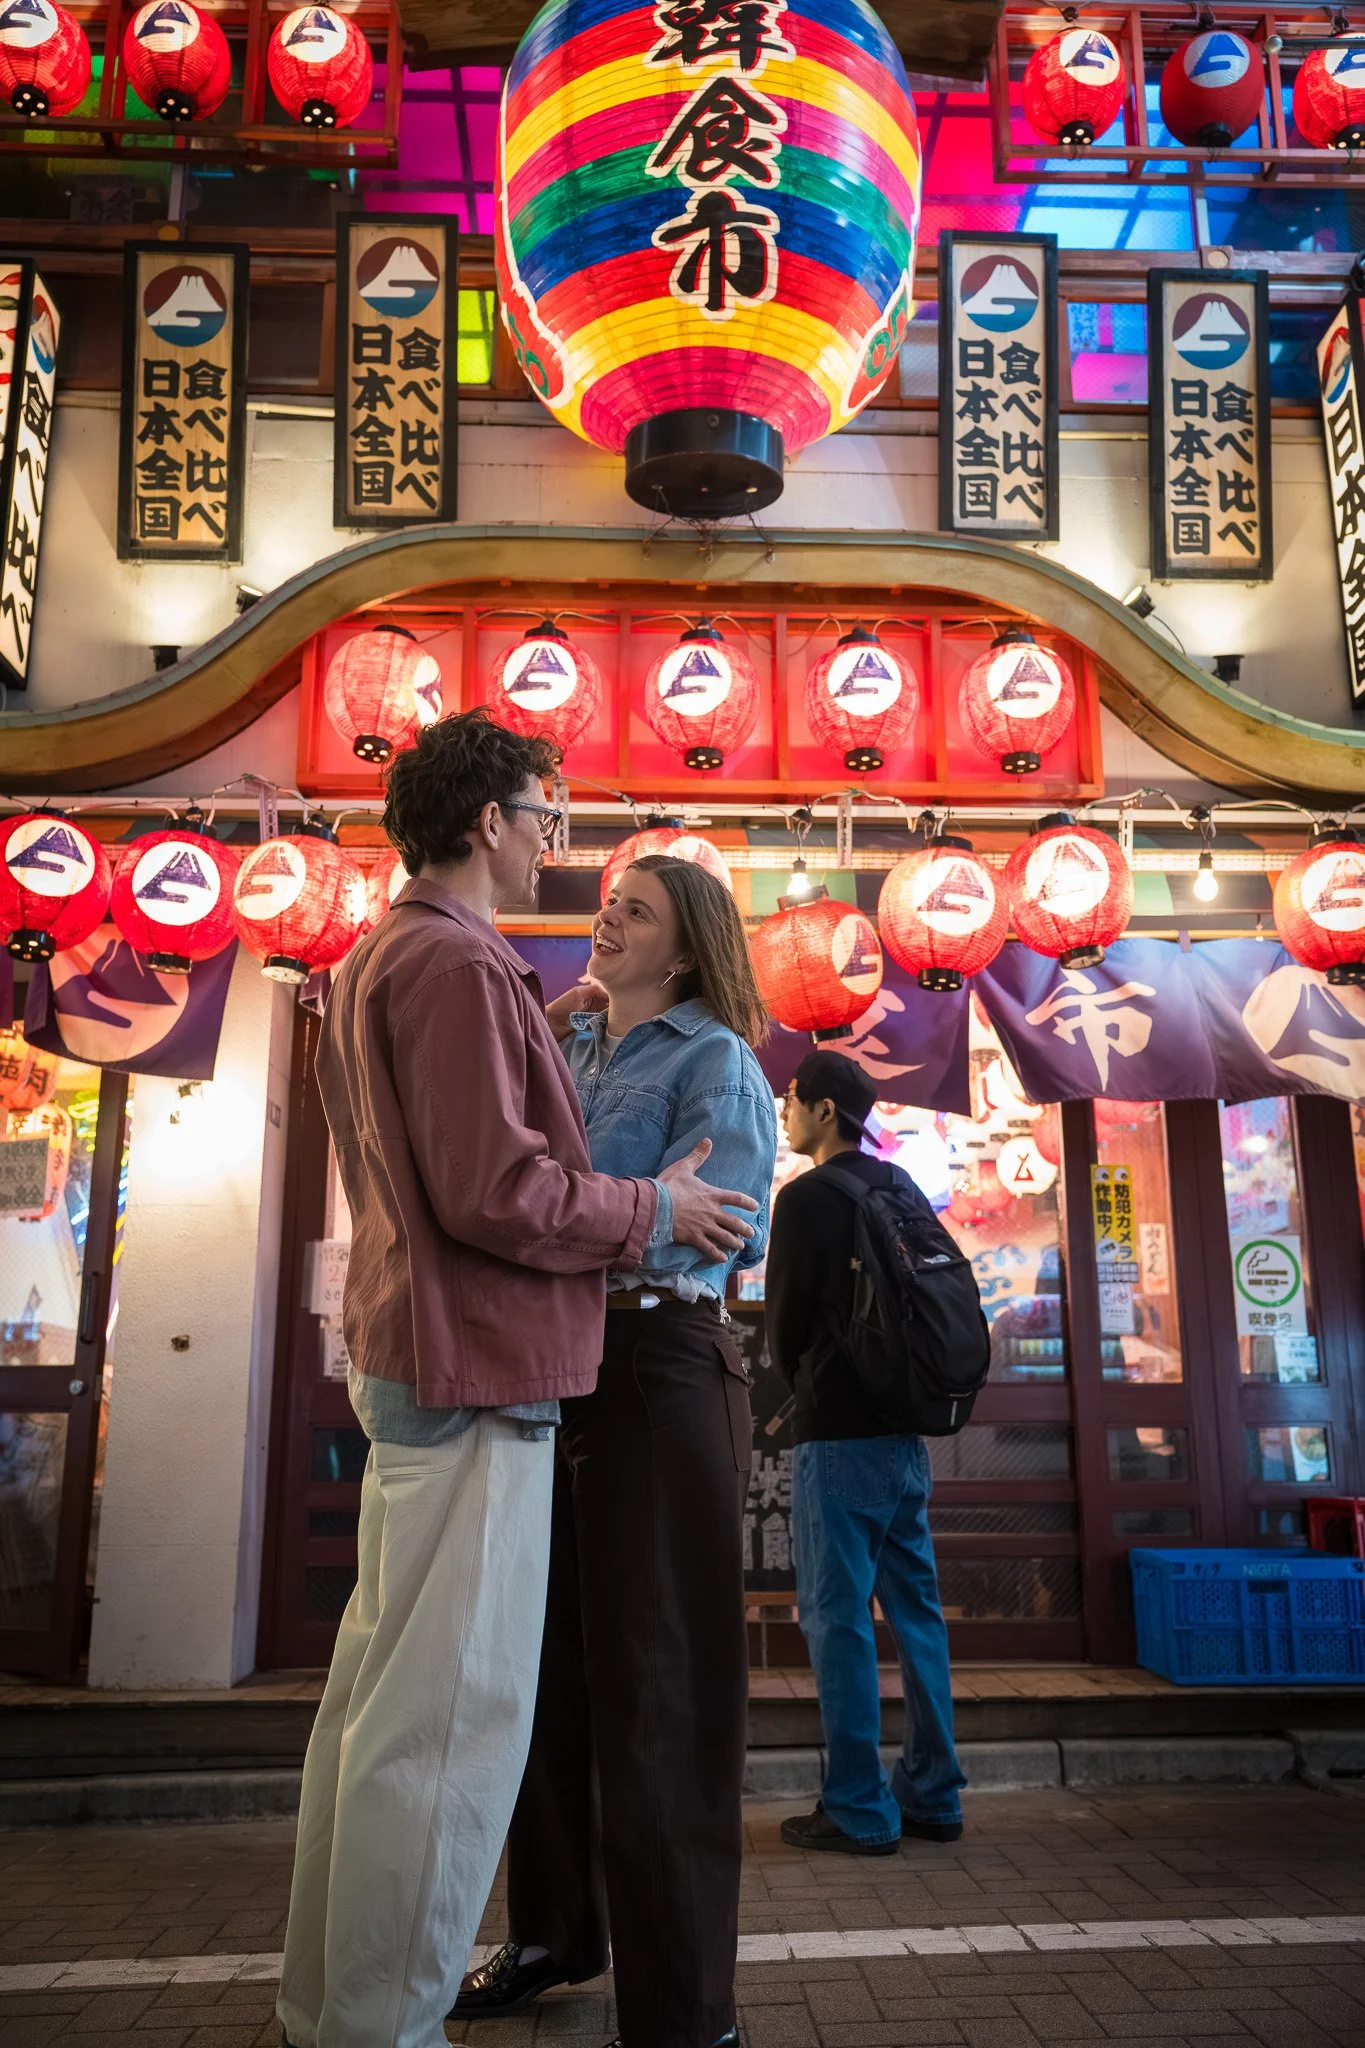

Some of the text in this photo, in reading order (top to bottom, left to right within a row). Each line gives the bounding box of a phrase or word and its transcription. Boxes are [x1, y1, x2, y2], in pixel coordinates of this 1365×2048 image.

[136, 357, 184, 540] 日本全国
[182, 358, 229, 539] 食べ比べ
[350, 323, 397, 506] 日本全国
[395, 326, 442, 510] 食べ比べ
[955, 337, 1000, 519] 日本全国
[997, 340, 1045, 519] 食べ比べ
[1169, 377, 1214, 555] 日本全国
[1211, 380, 1259, 555] 食べ比べ
[1023, 967, 1158, 1093] 市
[1113, 1183, 1133, 1260] 防犯カメラ
